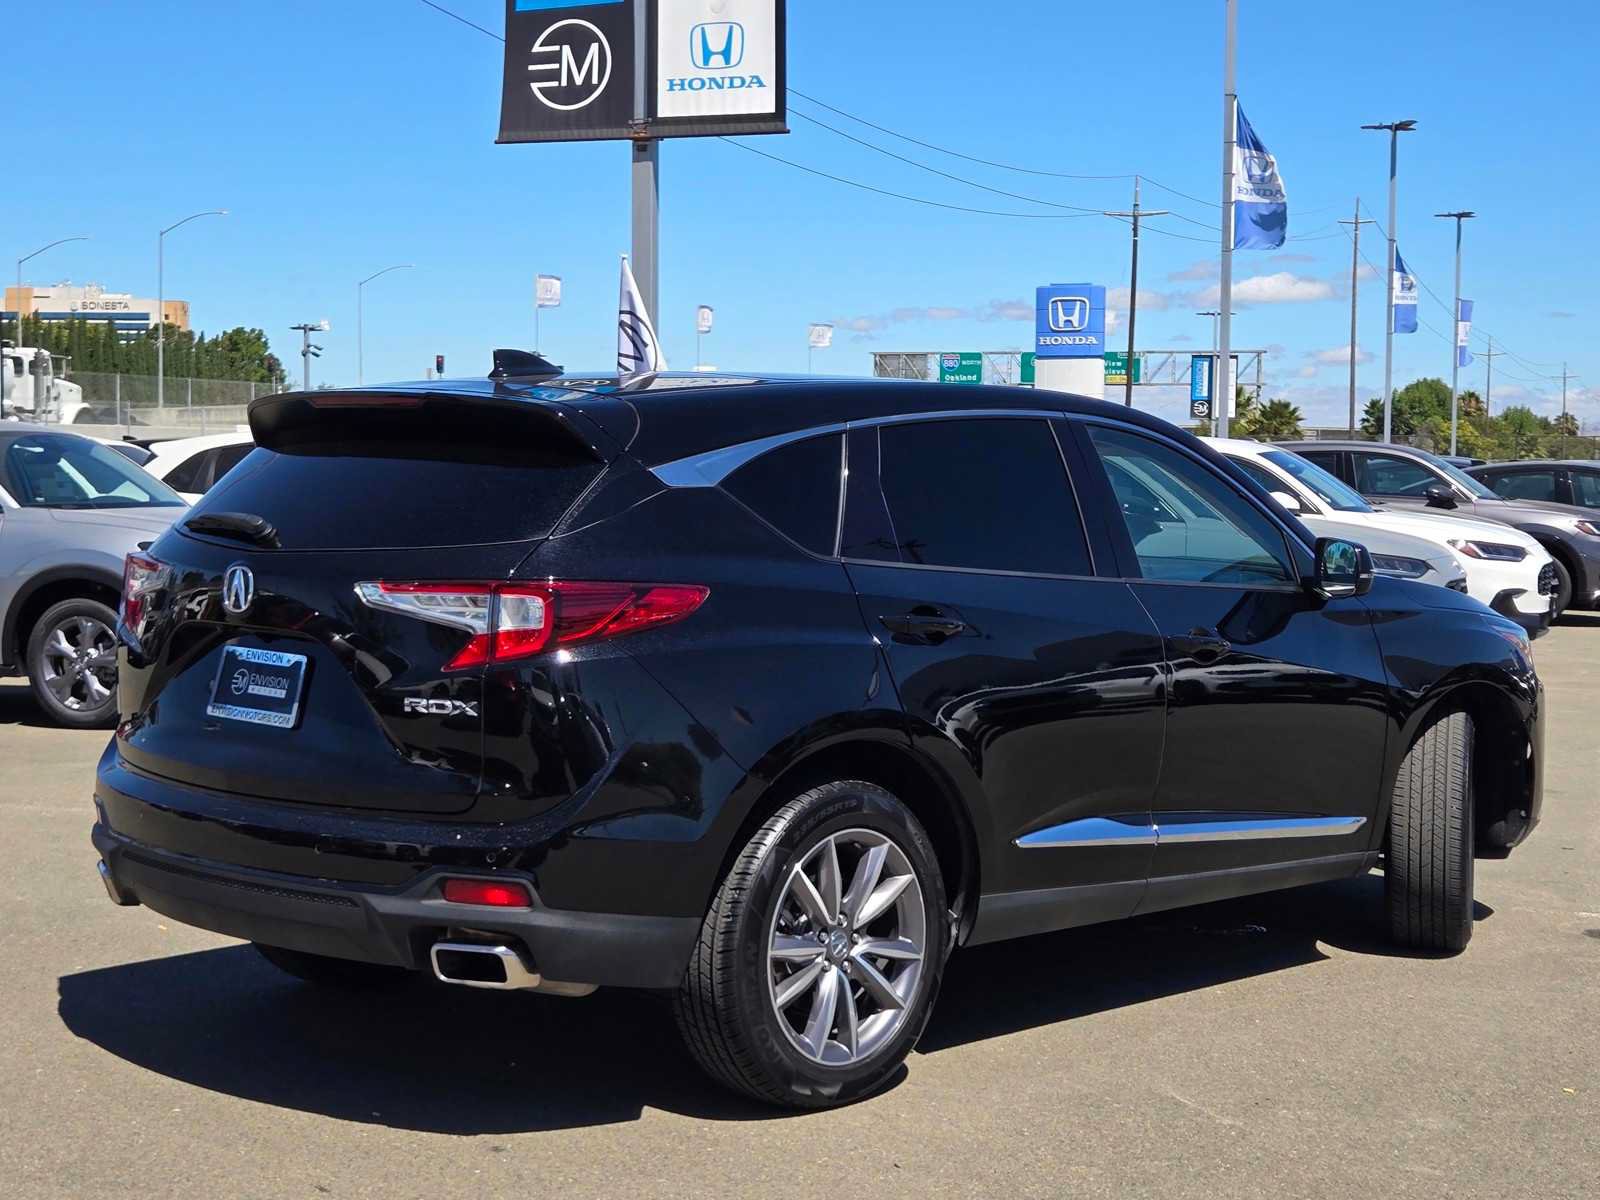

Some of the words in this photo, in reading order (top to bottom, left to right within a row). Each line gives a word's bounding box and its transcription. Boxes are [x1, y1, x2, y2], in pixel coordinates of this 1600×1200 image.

[667, 75, 766, 92] HONDA
[81, 301, 129, 310] SONESTA
[1039, 336, 1099, 345] HONDA
[246, 649, 284, 664] ENVISION
[249, 673, 290, 690] ENVISION
[404, 697, 478, 717] RDX
